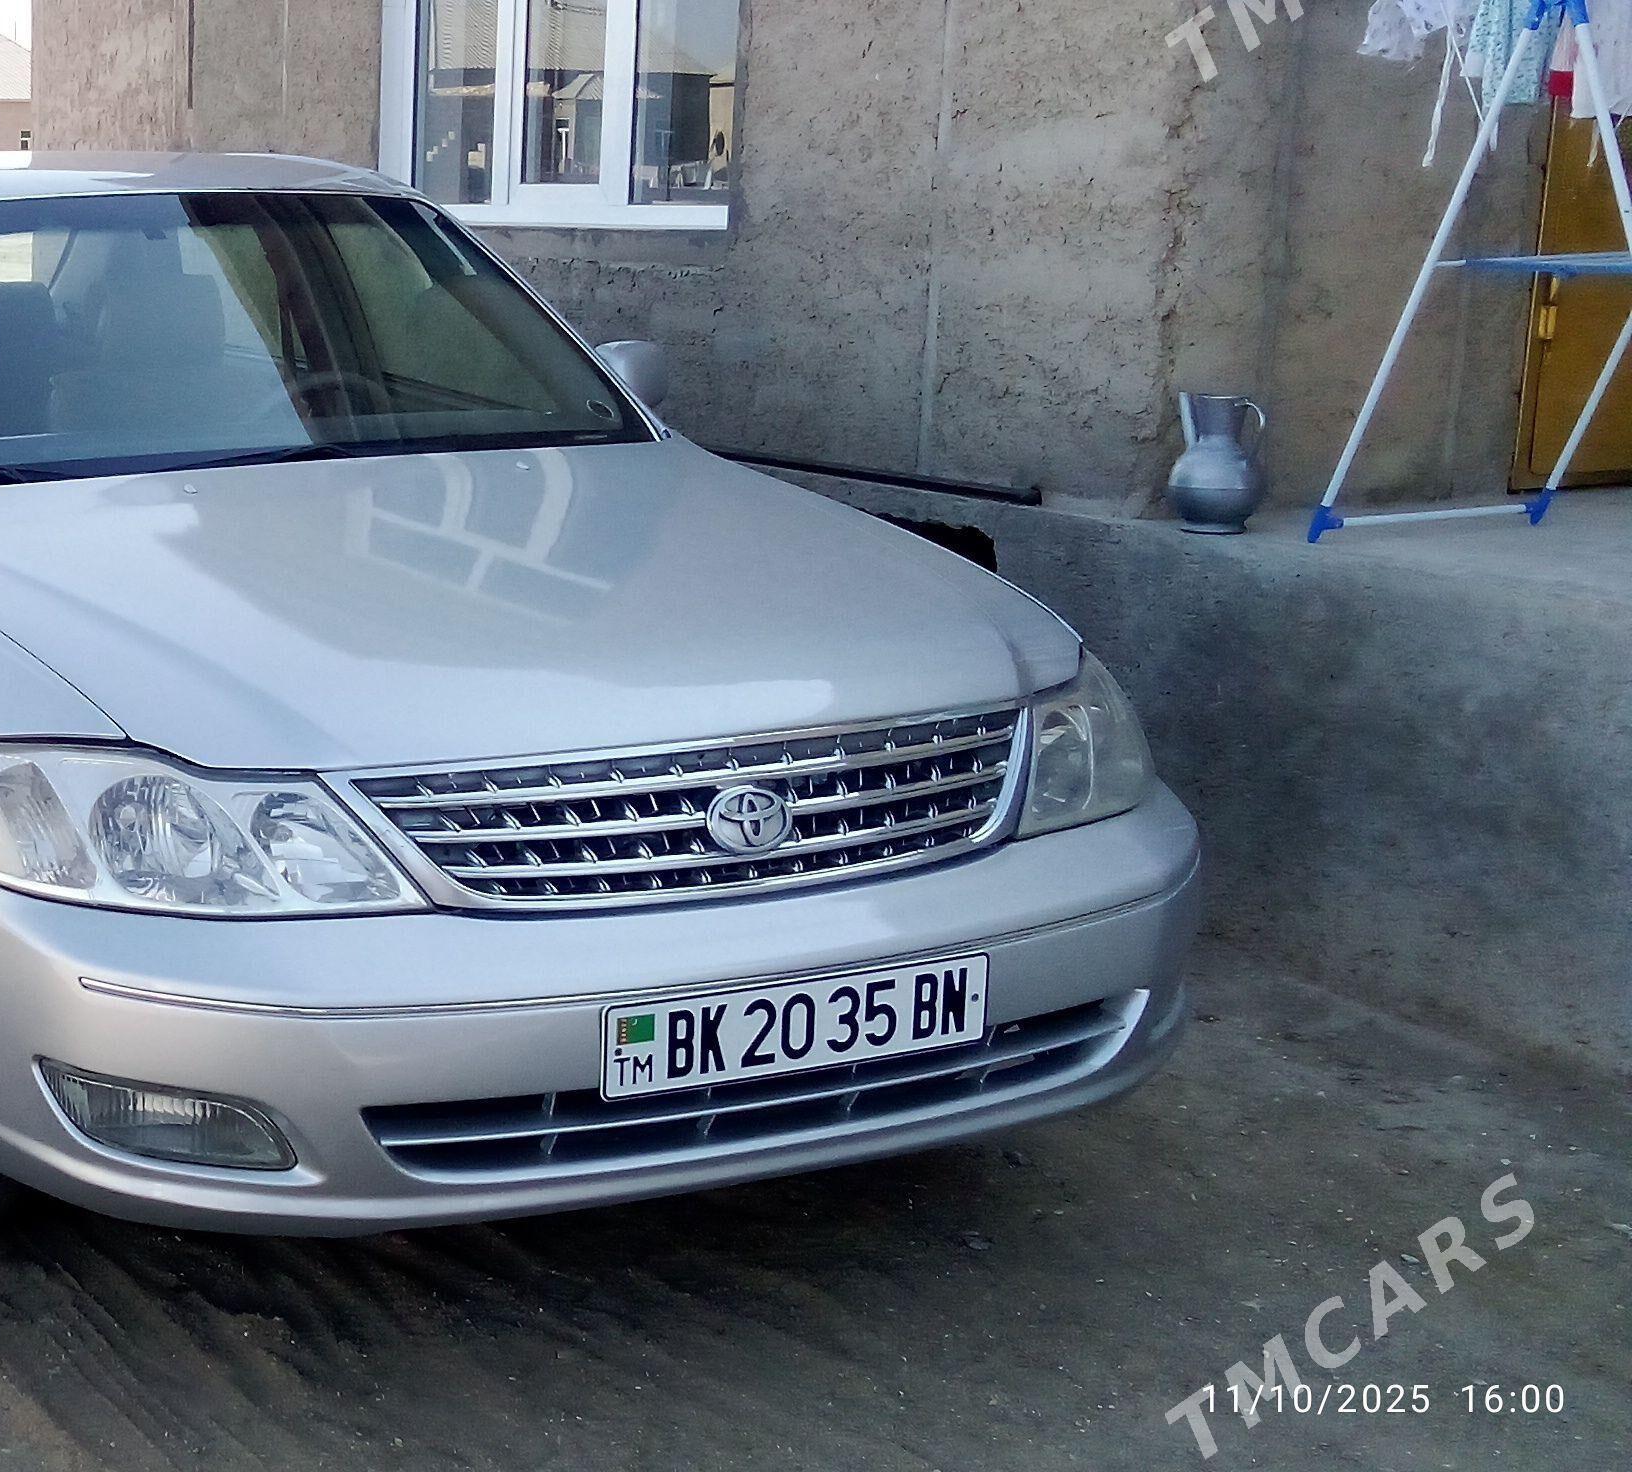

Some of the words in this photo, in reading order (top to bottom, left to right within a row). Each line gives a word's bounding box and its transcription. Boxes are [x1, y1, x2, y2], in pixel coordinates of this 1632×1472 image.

[667, 1003, 728, 1079] BK
[740, 992, 816, 1069] 20
[826, 979, 897, 1053] 35
[912, 967, 968, 1040] BN
[613, 1053, 654, 1087] TM
